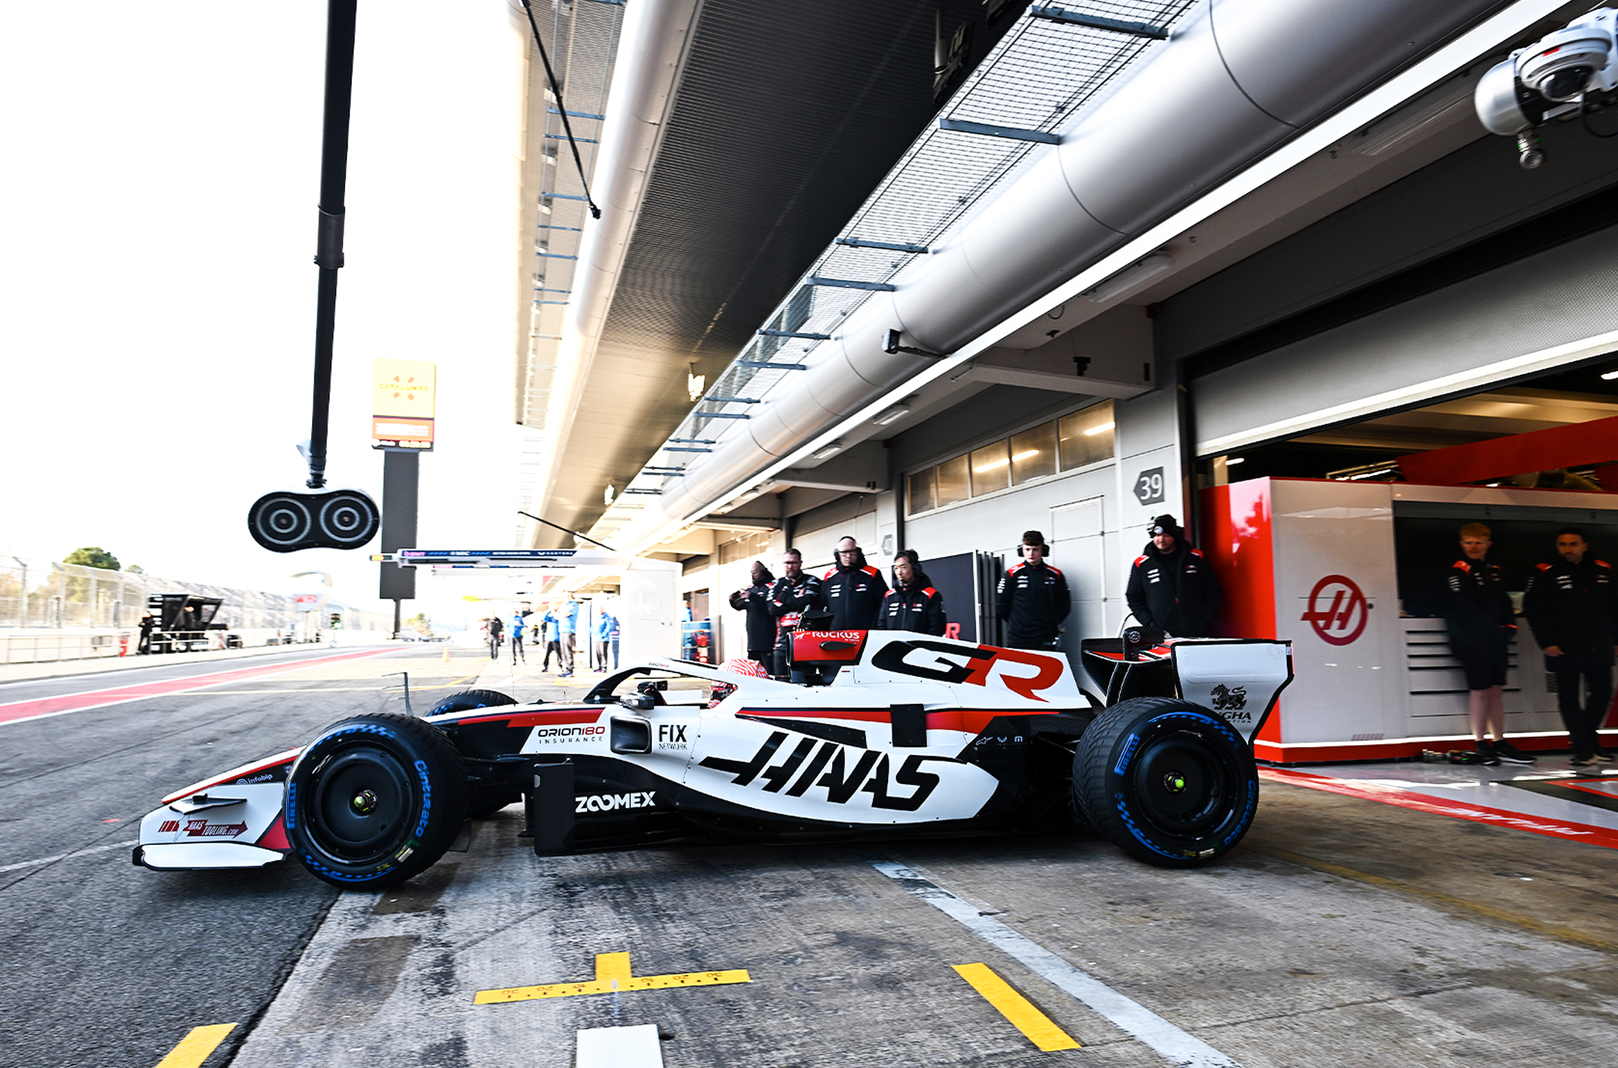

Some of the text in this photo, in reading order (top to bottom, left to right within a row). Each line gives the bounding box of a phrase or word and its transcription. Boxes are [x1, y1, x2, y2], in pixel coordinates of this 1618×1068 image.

[1139, 473, 1163, 500] 39
[812, 630, 860, 640] RUCKUS
[871, 640, 1064, 703] GR
[538, 726, 605, 738] ORION180
[539, 737, 603, 745] INSURANCE
[658, 724, 688, 743] FIX
[658, 742, 688, 750] NETWORK
[1113, 733, 1141, 776] PIRELLI
[248, 773, 273, 784] infobip
[697, 730, 968, 812] HAAS
[286, 782, 297, 829] PIRELLI
[575, 790, 657, 813] ZOOMEX
